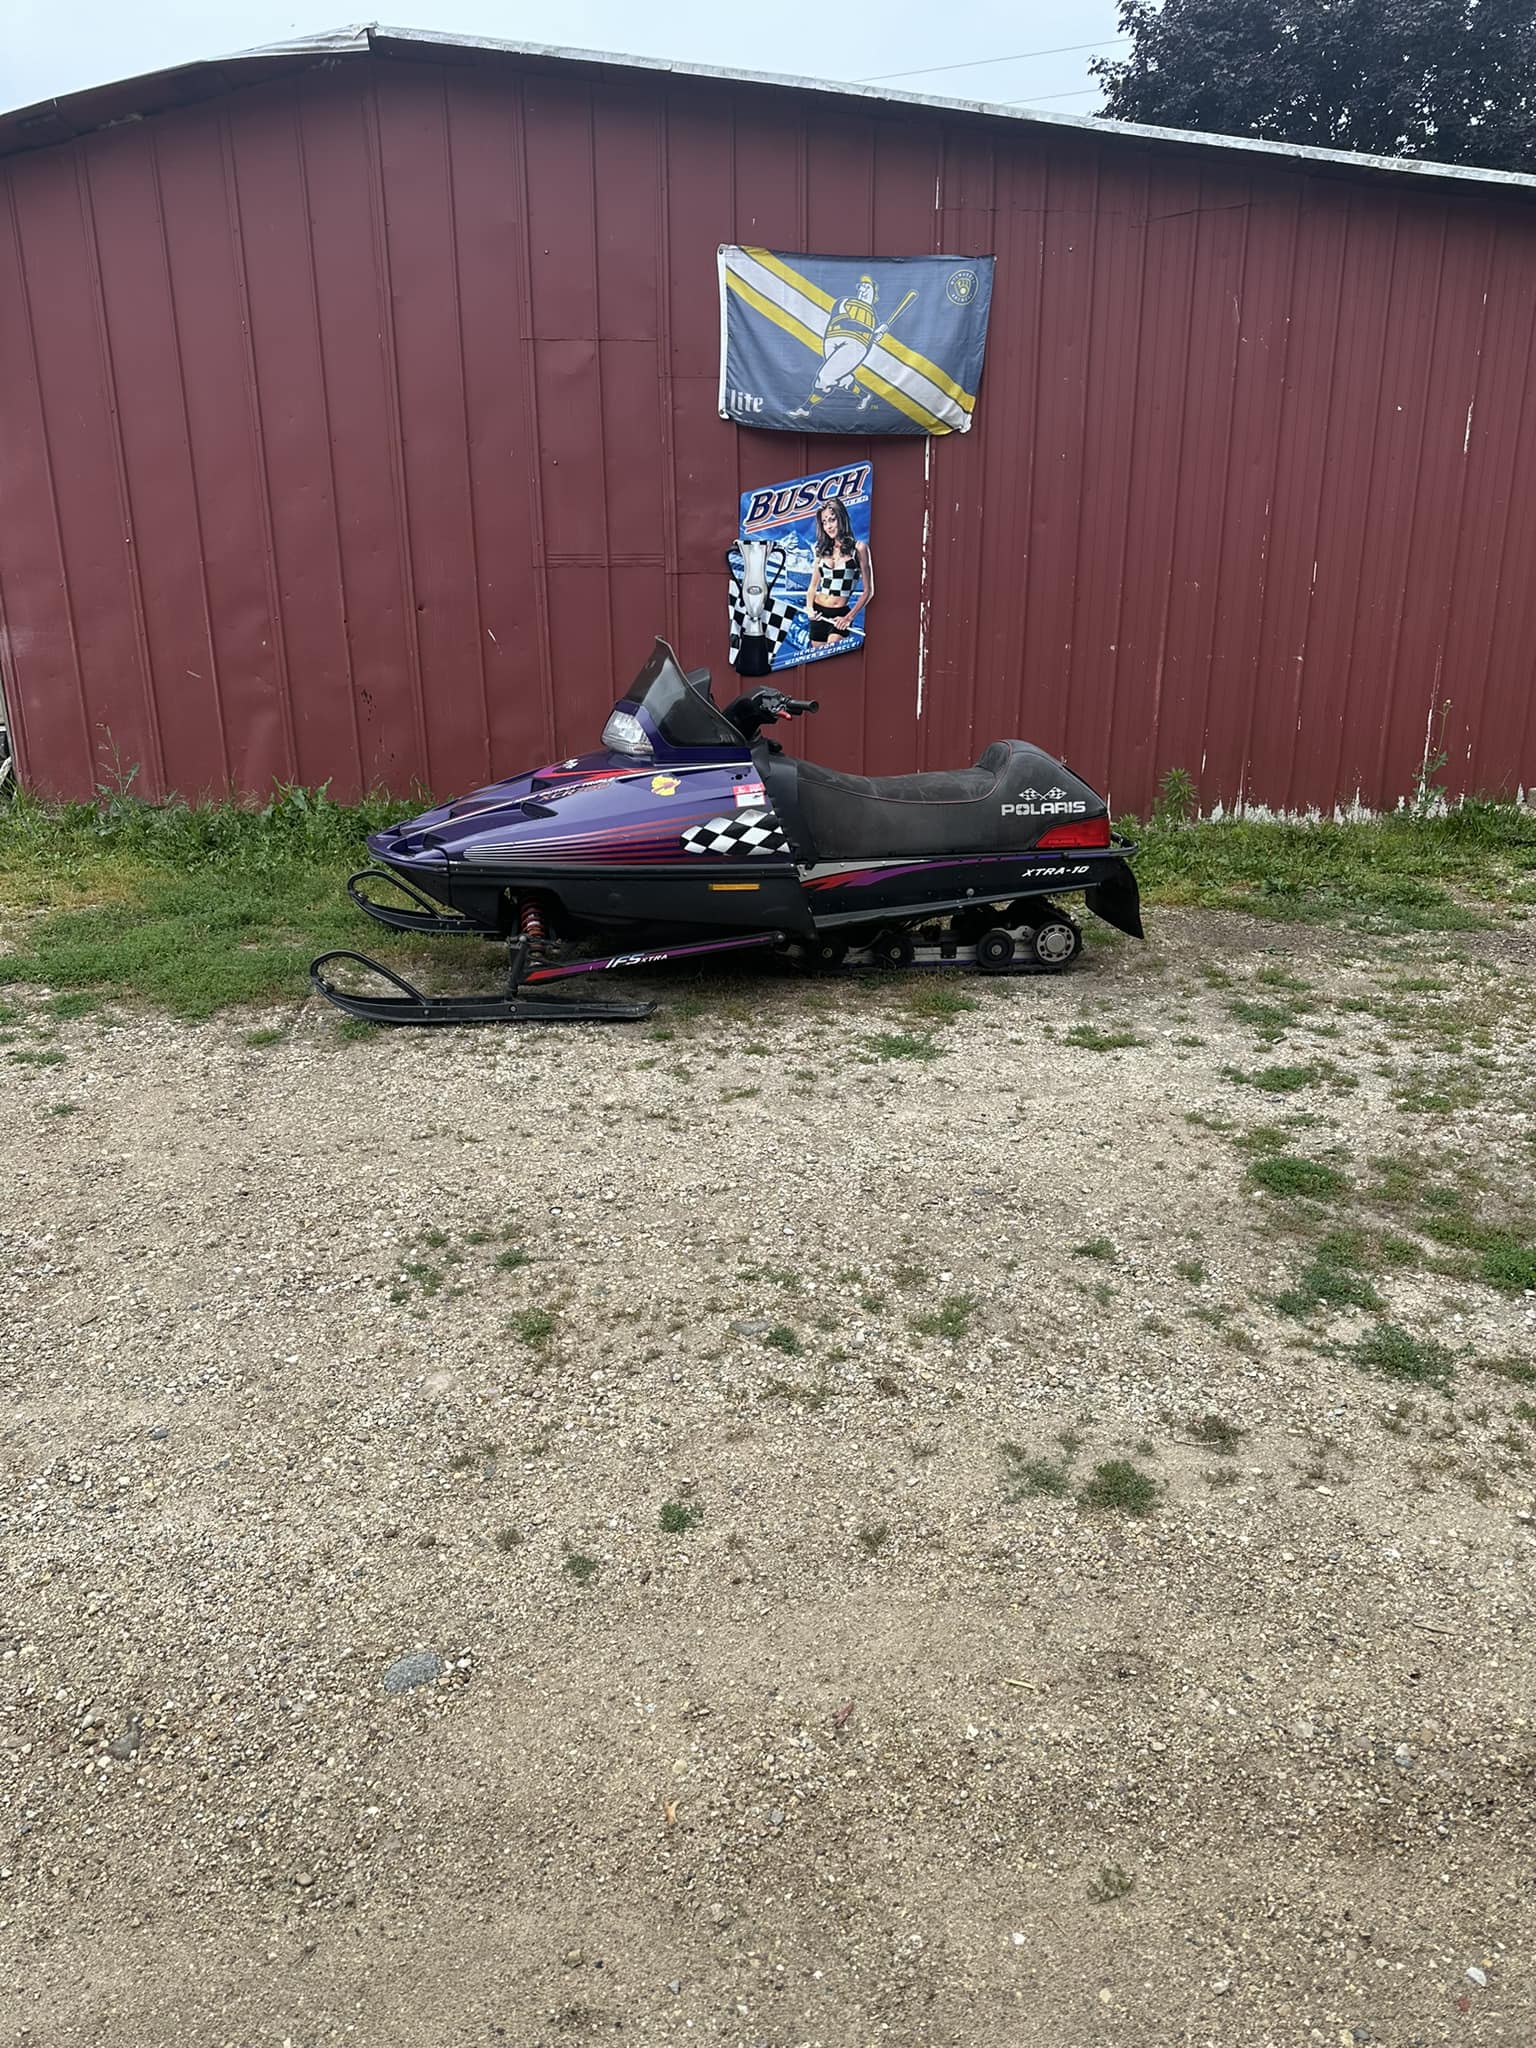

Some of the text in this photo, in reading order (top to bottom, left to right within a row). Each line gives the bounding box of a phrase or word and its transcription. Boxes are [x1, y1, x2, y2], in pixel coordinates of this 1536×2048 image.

[745, 467, 868, 525] BUSCH
[1001, 801, 1086, 816] POLARIS
[1021, 865, 1090, 878] XTRA-10
[605, 953, 645, 969] IFS
